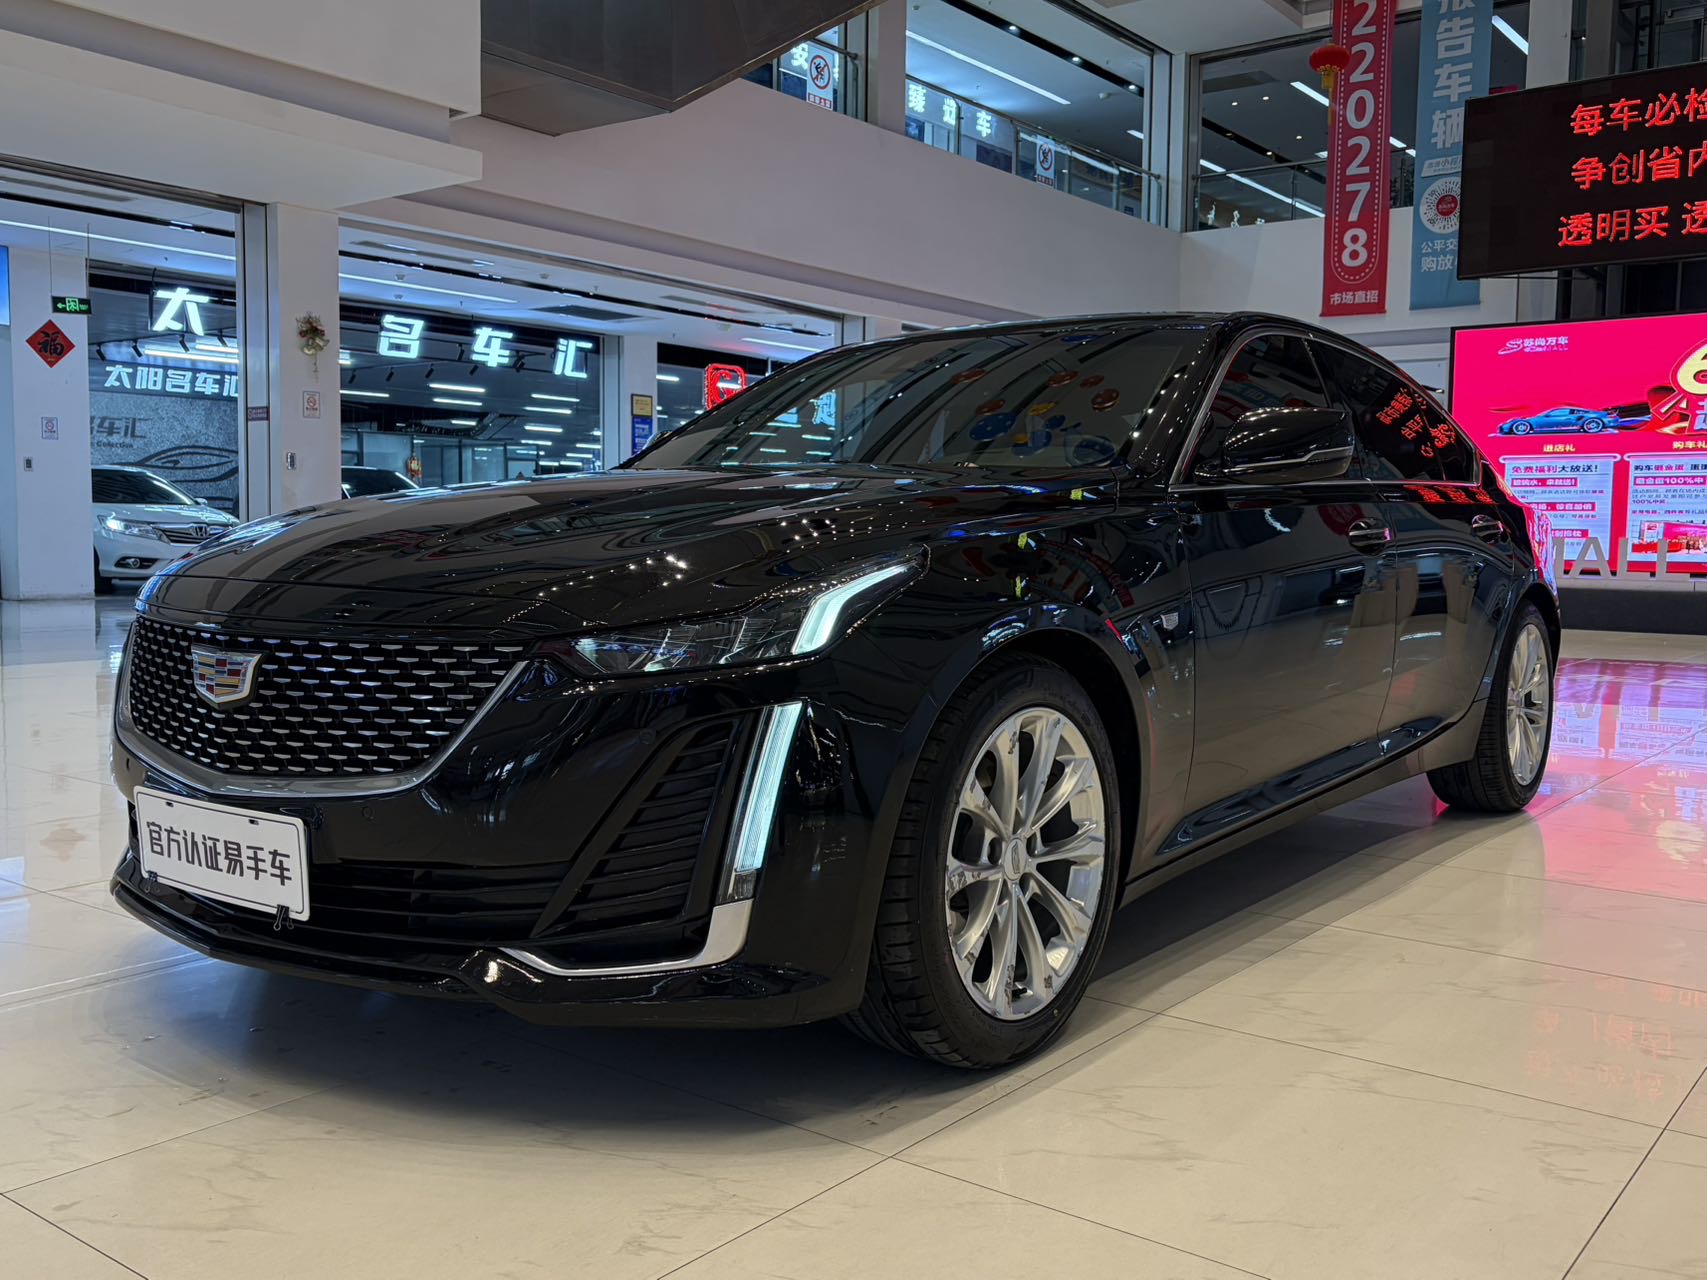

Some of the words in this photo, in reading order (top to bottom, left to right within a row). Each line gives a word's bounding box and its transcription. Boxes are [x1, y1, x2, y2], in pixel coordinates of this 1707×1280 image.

[1558, 205, 1669, 247] 透明买
[1421, 254, 1458, 272] 购放
[152, 287, 210, 336] 太
[1330, 290, 1379, 305] 市场直招
[37, 330, 65, 357] 福
[378, 314, 593, 379] 名车汇
[104, 365, 238, 397] 太阳名车汇
[90, 416, 151, 440] 车汇
[146, 821, 293, 887] 官方认证易手车
